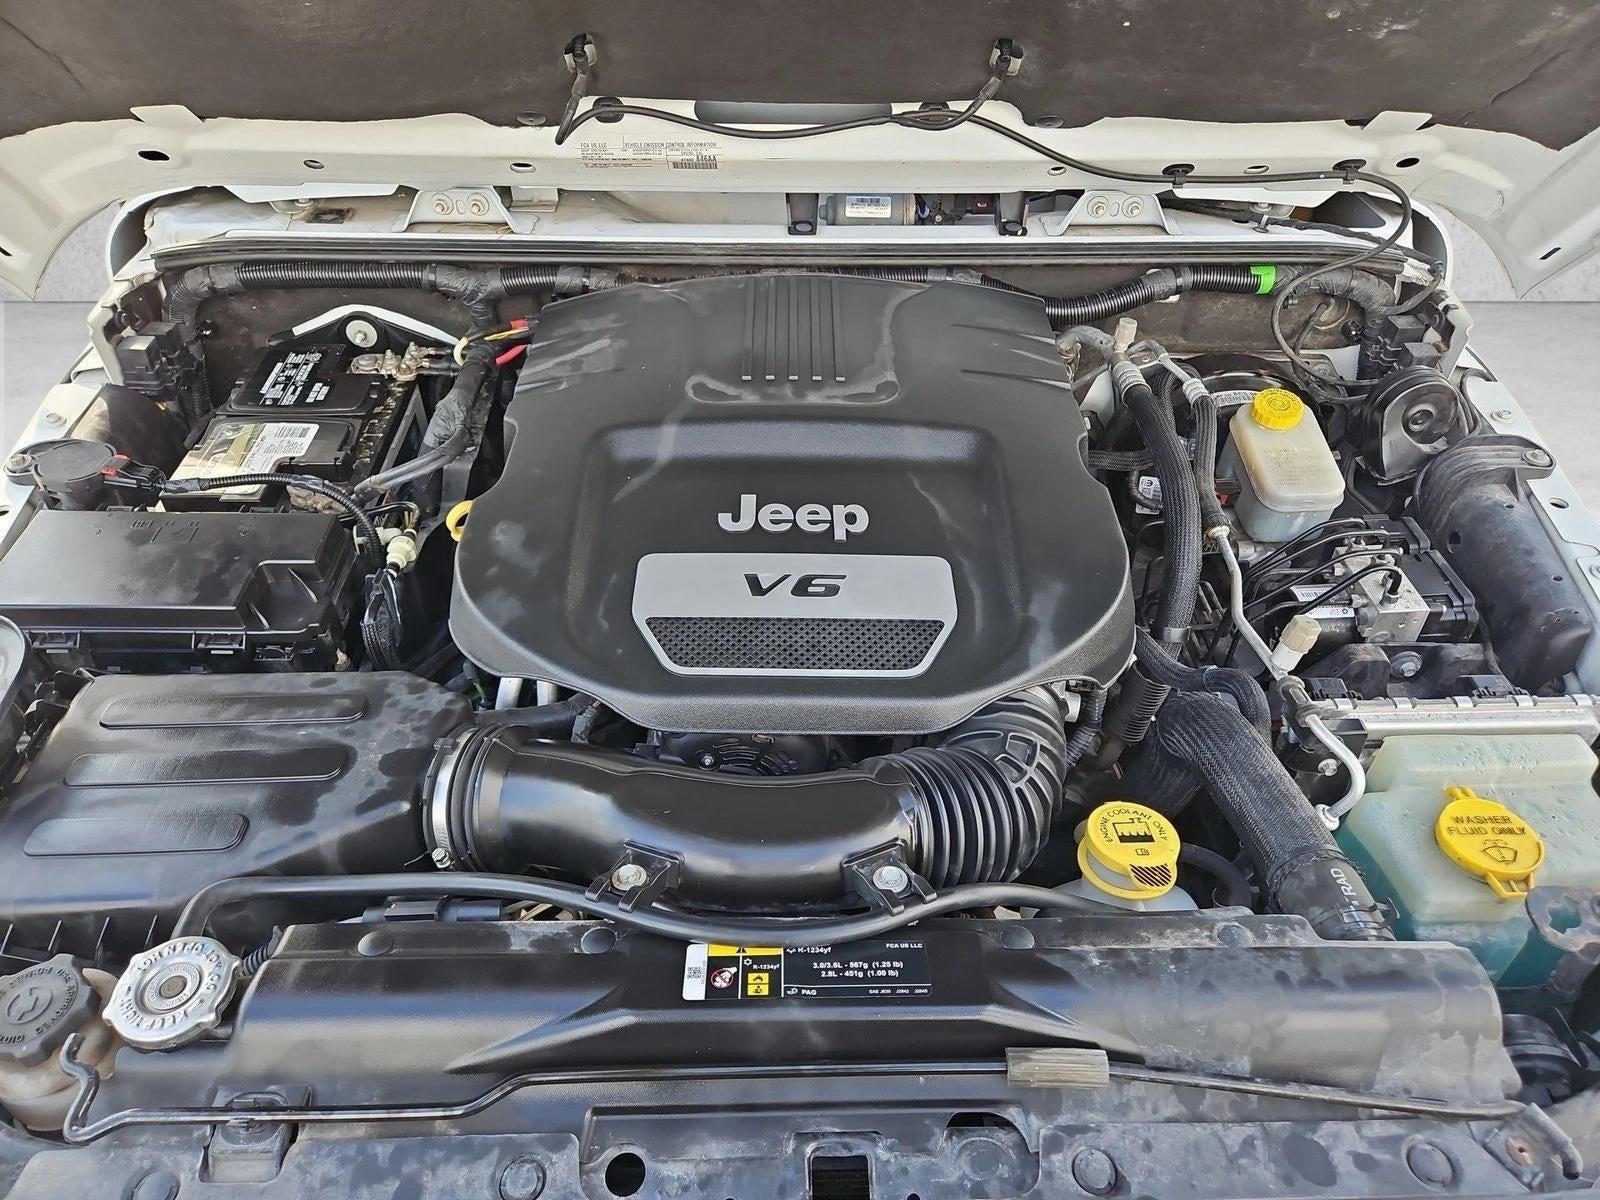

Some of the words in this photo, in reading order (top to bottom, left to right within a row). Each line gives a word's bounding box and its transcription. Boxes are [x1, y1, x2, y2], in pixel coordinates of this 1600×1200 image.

[717, 494, 870, 542] Jeep
[744, 573, 848, 598] V6
[1100, 816, 1114, 843] ENGINE
[1108, 808, 1152, 820] COOLANT
[1153, 820, 1168, 841] ONLY
[1451, 816, 1513, 824] WASHER
[1448, 826, 1488, 836] FLUID
[1491, 826, 1526, 836] ONLY
[1330, 868, 1357, 897] RAD
[849, 961, 869, 969] 567g
[872, 961, 891, 969] (1.25
[892, 961, 903, 969] lb)
[821, 970, 838, 978] 2.8L
[844, 970, 864, 978] 451g
